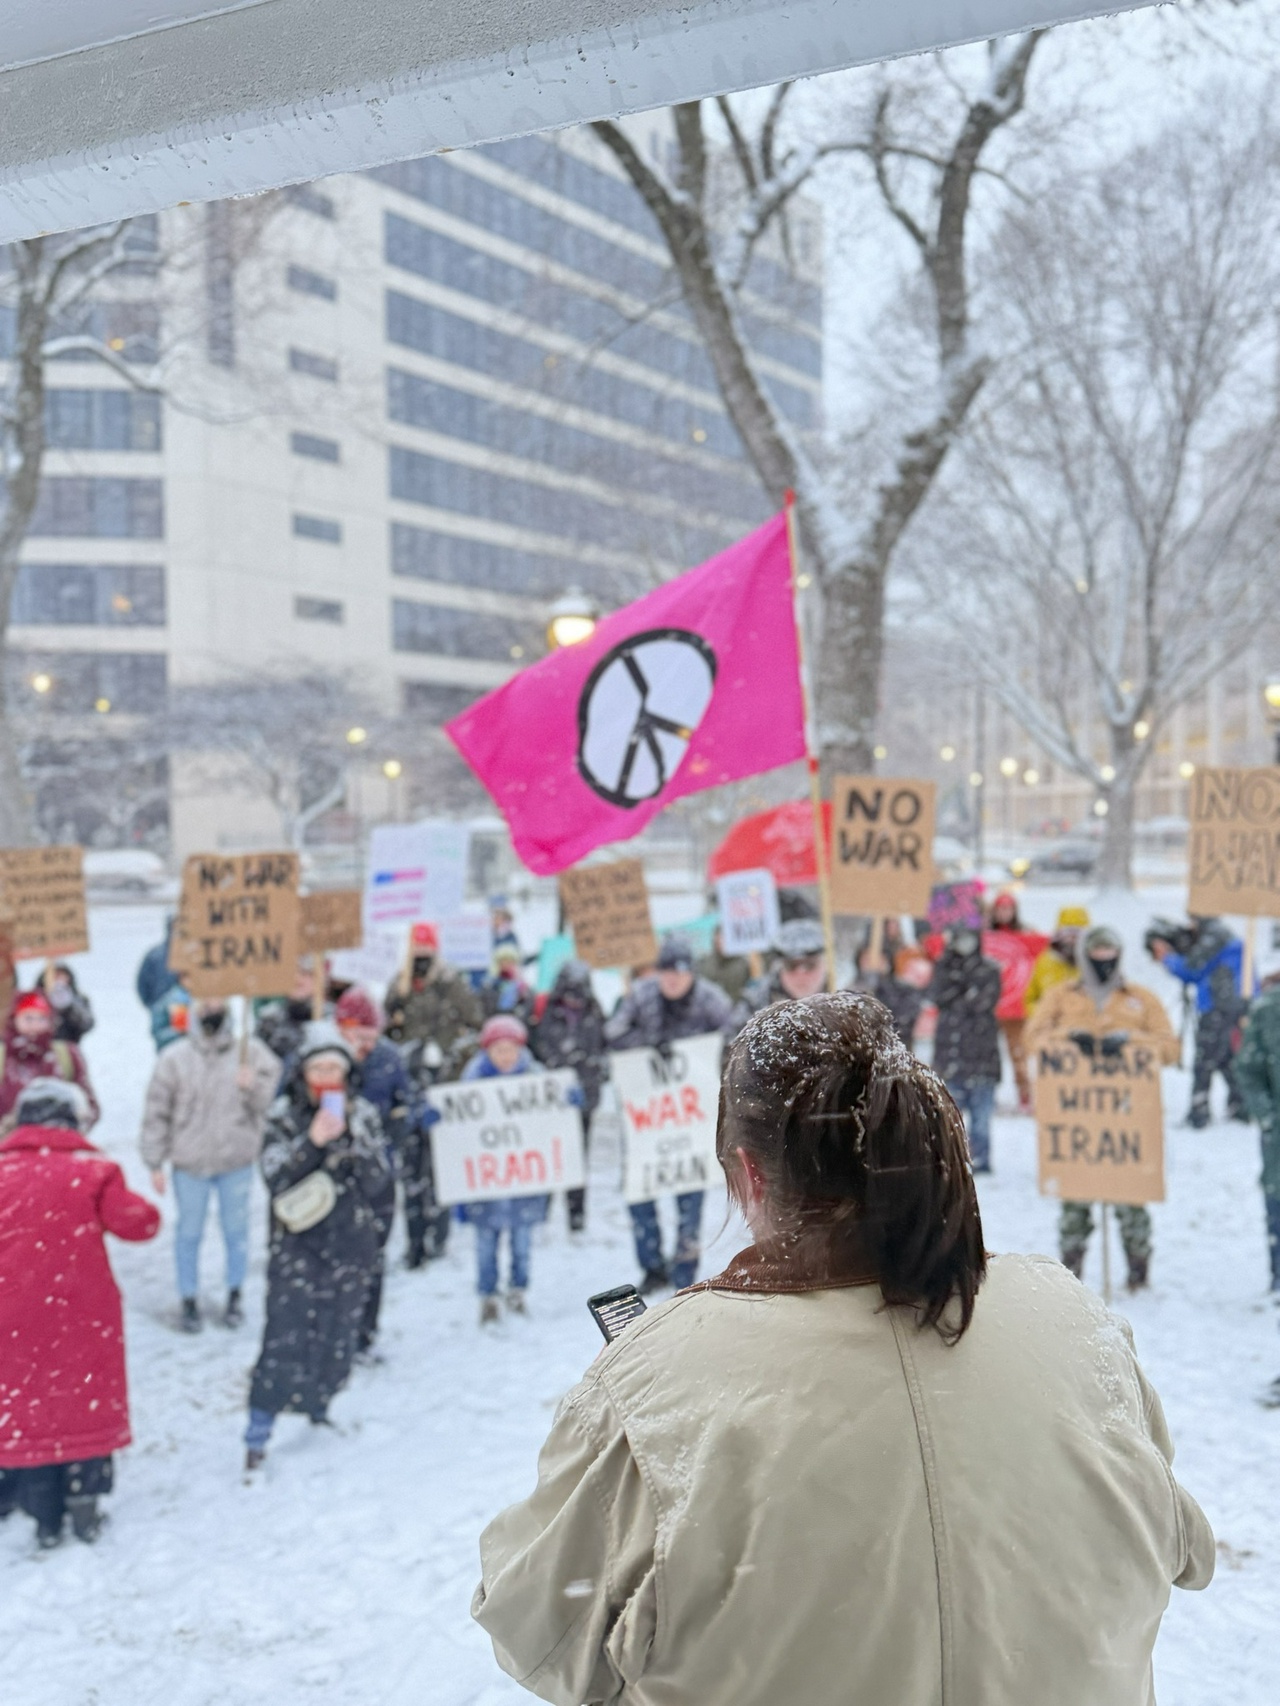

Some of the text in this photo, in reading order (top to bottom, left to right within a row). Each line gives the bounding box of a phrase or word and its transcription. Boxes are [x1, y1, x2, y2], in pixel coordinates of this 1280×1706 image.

[847, 788, 922, 826] NO
[1195, 769, 1280, 826] NO
[838, 830, 923, 871] WAR
[1192, 827, 1280, 893] WA
[199, 855, 294, 889] NO WAR
[207, 896, 270, 926] WITH
[200, 934, 282, 968] IRAN
[648, 1047, 688, 1084] NO
[1039, 1047, 1078, 1077] NO
[443, 1078, 569, 1122] NO WAR
[624, 1083, 706, 1133] WAR
[1058, 1086, 1132, 1114] WITH
[1046, 1124, 1142, 1165] IRAN
